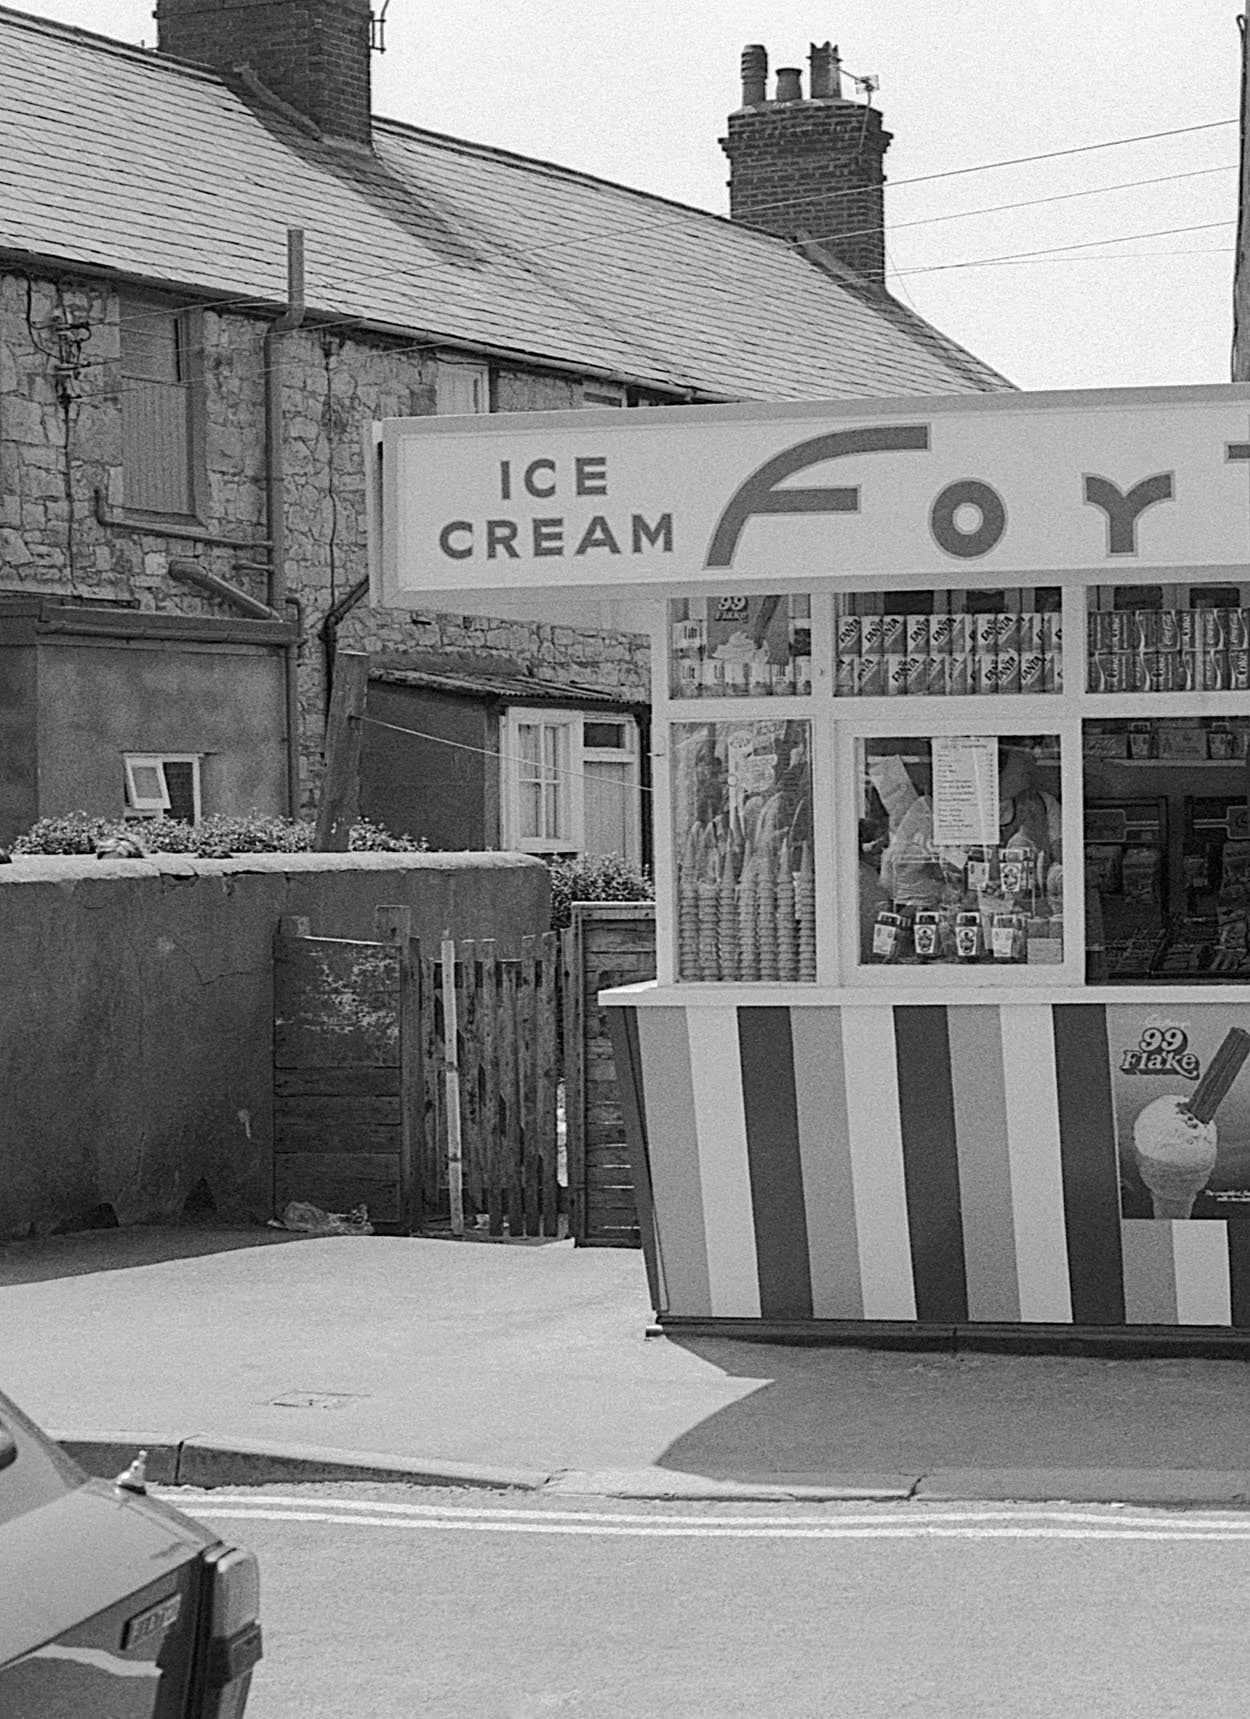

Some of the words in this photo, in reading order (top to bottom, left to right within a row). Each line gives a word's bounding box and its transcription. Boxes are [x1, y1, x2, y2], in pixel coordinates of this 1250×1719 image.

[501, 457, 607, 500] ICE
[439, 513, 673, 560] CREAM
[718, 596, 748, 612] 99
[839, 618, 861, 643] FANTA
[1236, 652, 1248, 678] Coke
[1139, 1027, 1188, 1052] 99
[1120, 1049, 1200, 1081] Flake
